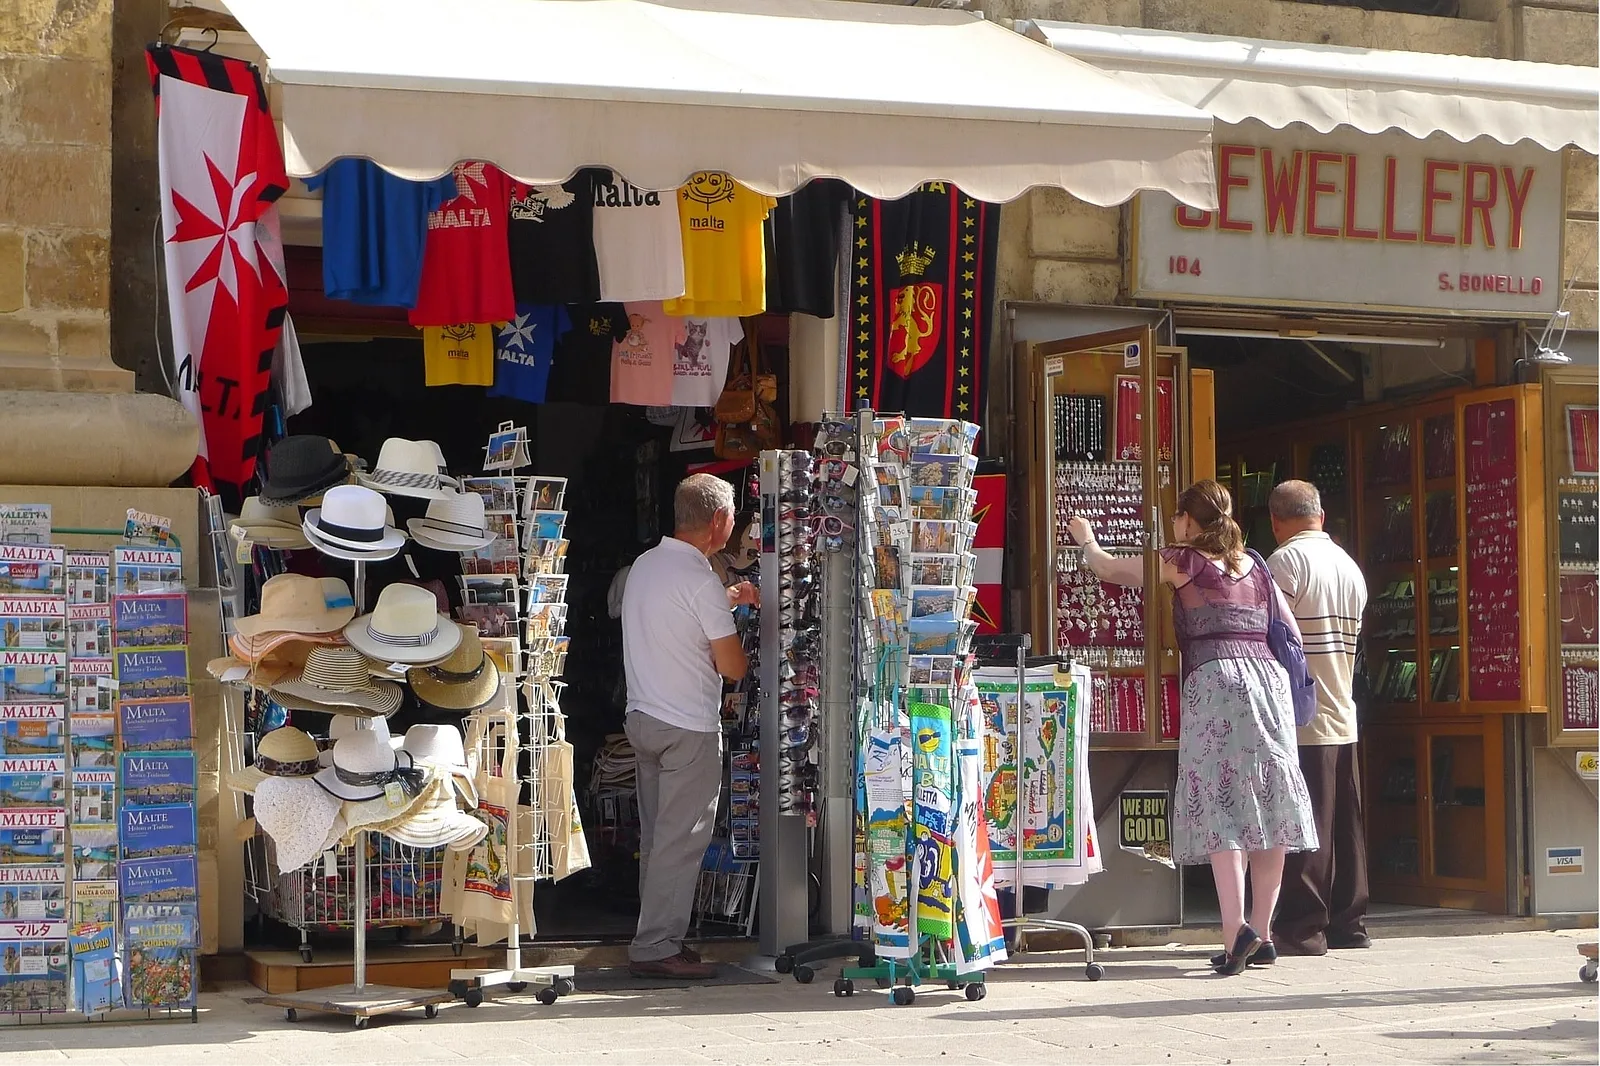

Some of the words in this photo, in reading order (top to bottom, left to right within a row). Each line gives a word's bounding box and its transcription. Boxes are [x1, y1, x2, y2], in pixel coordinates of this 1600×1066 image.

[428, 207, 491, 229] MALTA
[690, 216, 724, 229] malta
[1169, 256, 1202, 277] 104
[1438, 272, 1454, 291] S.
[1459, 273, 1543, 295] BONELLO
[447, 349, 469, 358] malta
[130, 512, 170, 527] MALTA
[2, 547, 56, 560] MALTA
[123, 551, 174, 563] MALTA
[71, 556, 105, 566] MALTA
[3, 601, 57, 613] МАЛЬТА
[72, 607, 107, 617] MALTE
[122, 600, 161, 614] MALTA
[4, 652, 58, 664] MALTA
[124, 653, 163, 666] MALTA
[73, 663, 110, 672] МАЛЬТА
[2, 706, 57, 718] MALTA
[126, 705, 166, 719] MALTA
[3, 760, 58, 771] MALTA
[129, 758, 169, 771] MALTA
[77, 773, 112, 782] MALTA
[1122, 799, 1141, 815] WE
[1143, 799, 1167, 815] BUY
[2, 814, 57, 826] MALTE
[128, 811, 168, 825] MALTE
[1124, 817, 1166, 841] GOLD
[1557, 857, 1573, 865] VISA
[14, 924, 51, 936] マルタ
